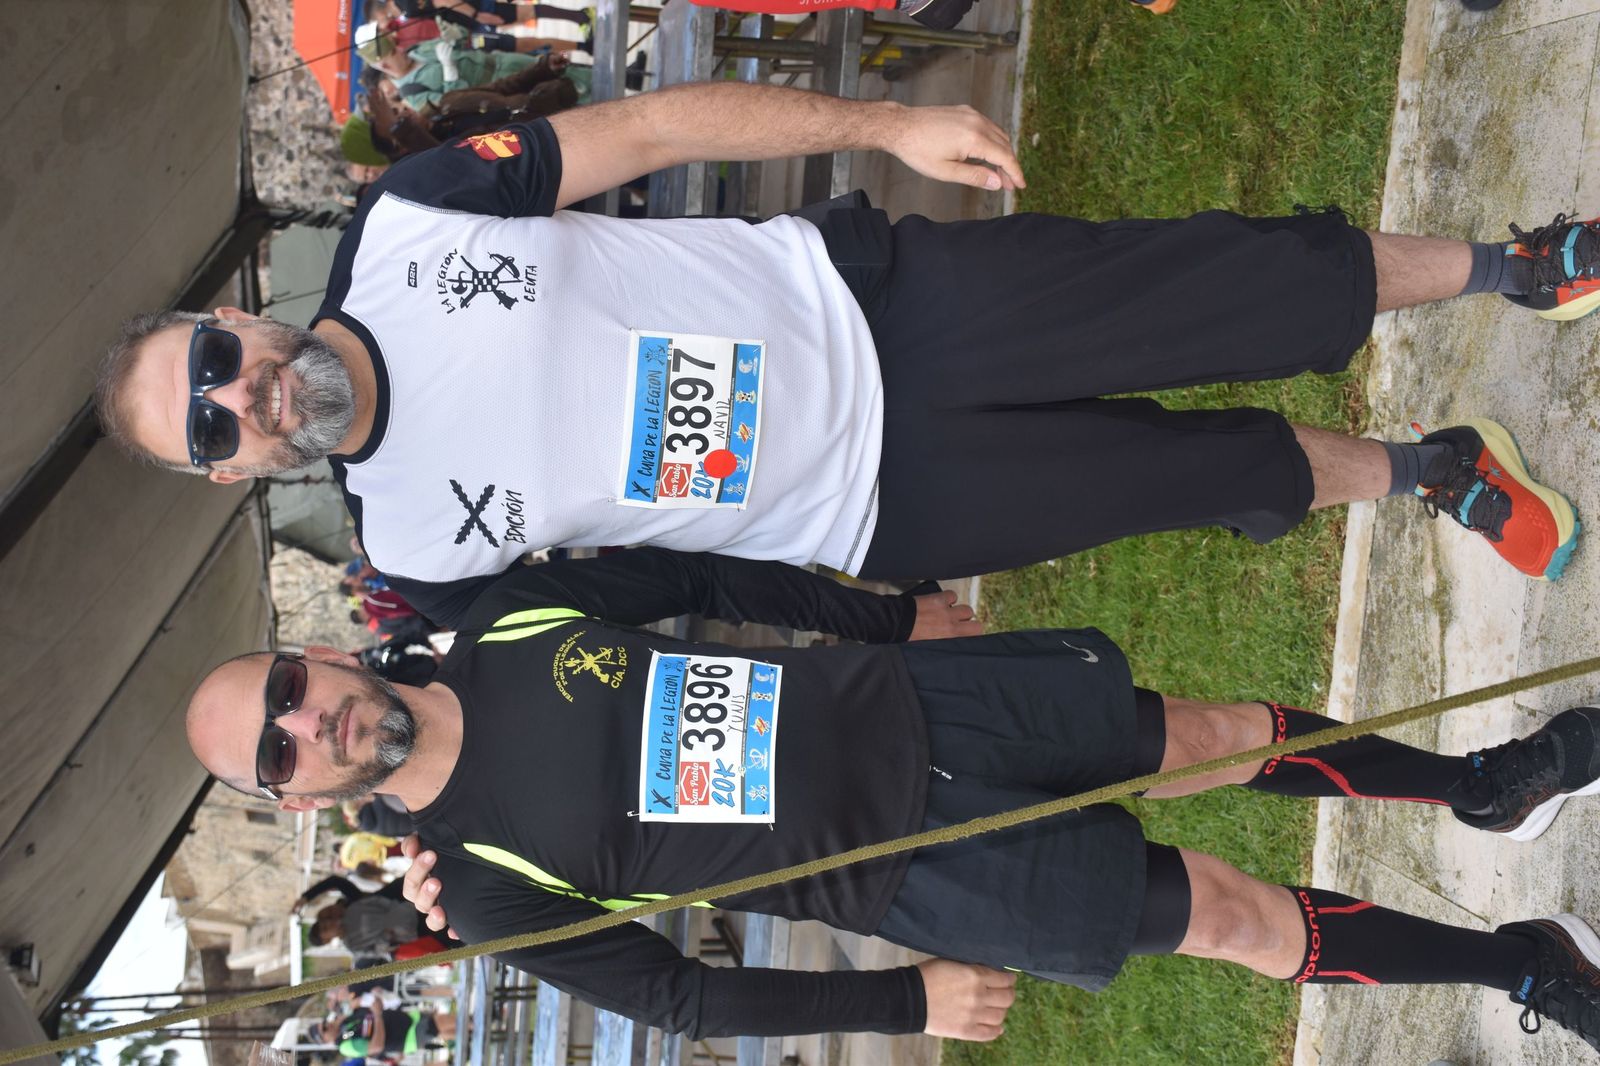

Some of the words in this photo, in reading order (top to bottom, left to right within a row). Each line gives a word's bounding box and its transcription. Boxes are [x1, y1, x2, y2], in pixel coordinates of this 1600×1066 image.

[523, 264, 538, 302] CEUTA
[441, 298, 456, 314] LA
[666, 348, 716, 455] 3897
[670, 464, 681, 484] Pablo
[631, 480, 650, 498] X
[669, 484, 678, 498] San
[501, 488, 528, 544] EDICIÓN
[617, 646, 628, 666] DCC
[556, 680, 574, 702] TERCIO
[682, 663, 733, 752] 3896
[726, 694, 745, 733] YUNIS
[690, 762, 699, 787] Pablo
[711, 758, 735, 808] 20K
[650, 788, 672, 808] X
[690, 789, 699, 805] San
[1294, 890, 1321, 984] aptonia
